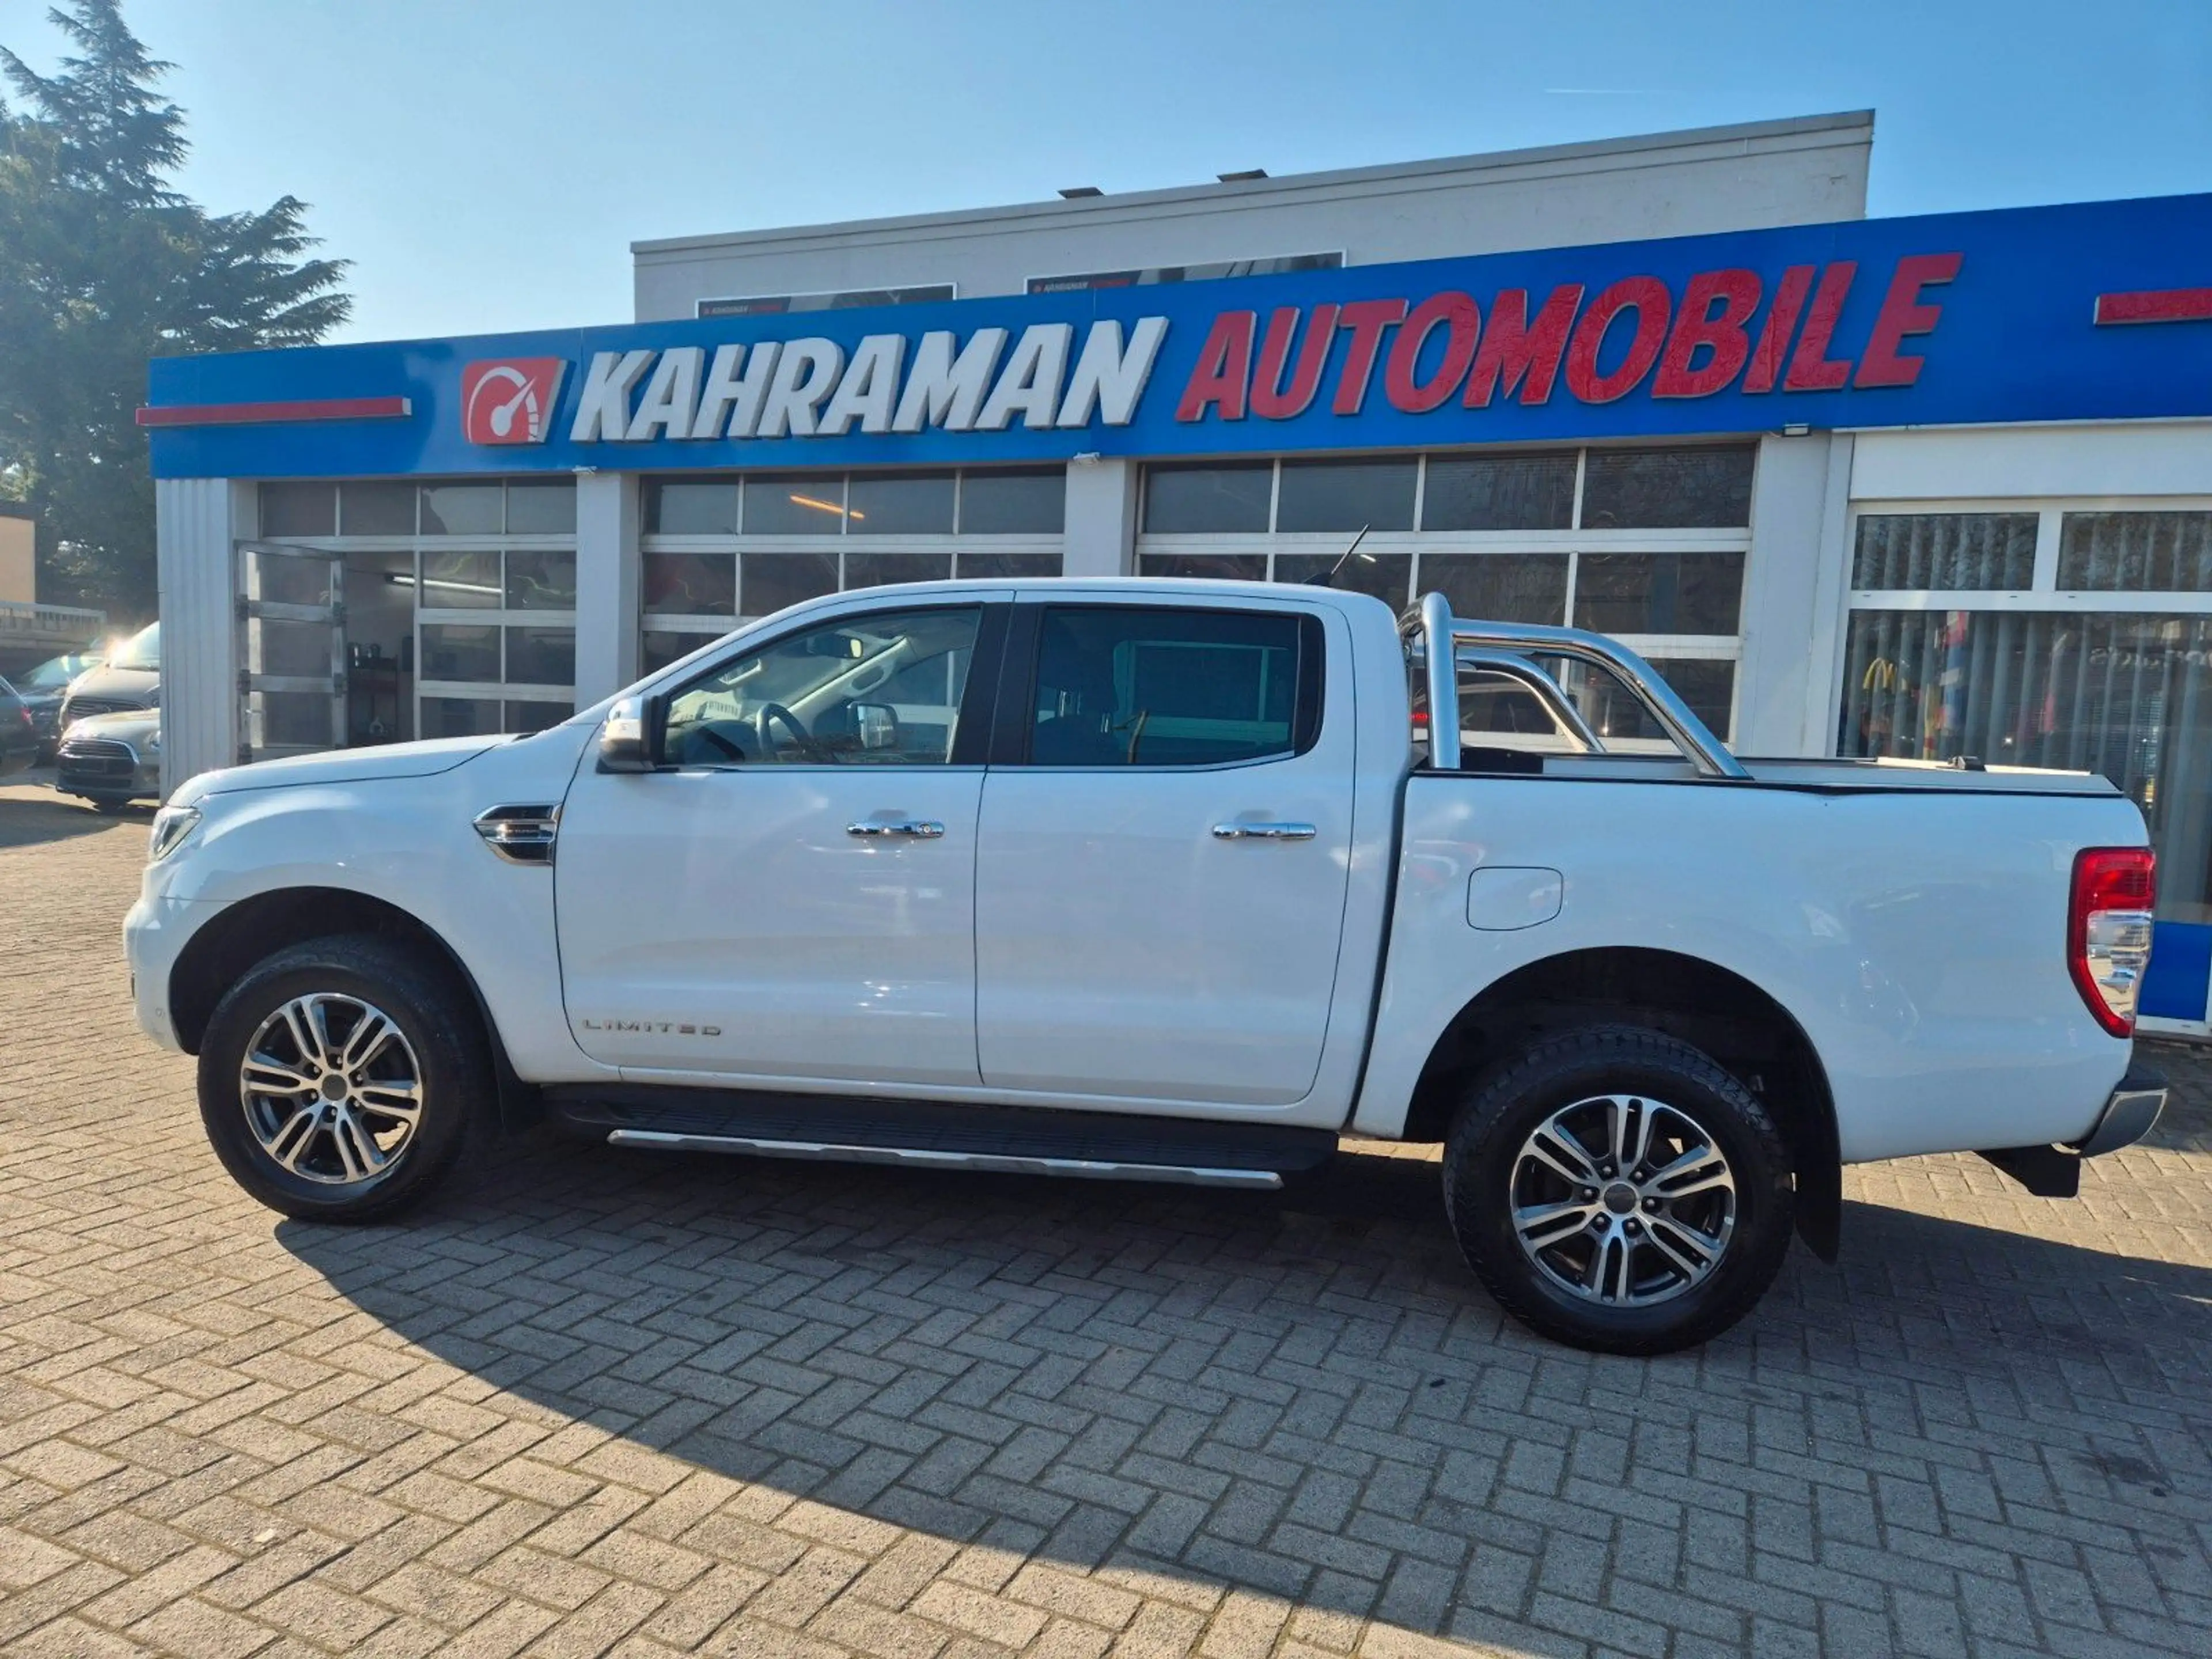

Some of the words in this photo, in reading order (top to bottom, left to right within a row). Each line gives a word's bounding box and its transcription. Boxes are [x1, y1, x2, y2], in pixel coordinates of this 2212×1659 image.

[570, 316, 1170, 442] KAHRAMAN
[1175, 252, 1963, 422] AUTOMOBILE
[583, 1018, 721, 1036] LIMITED
